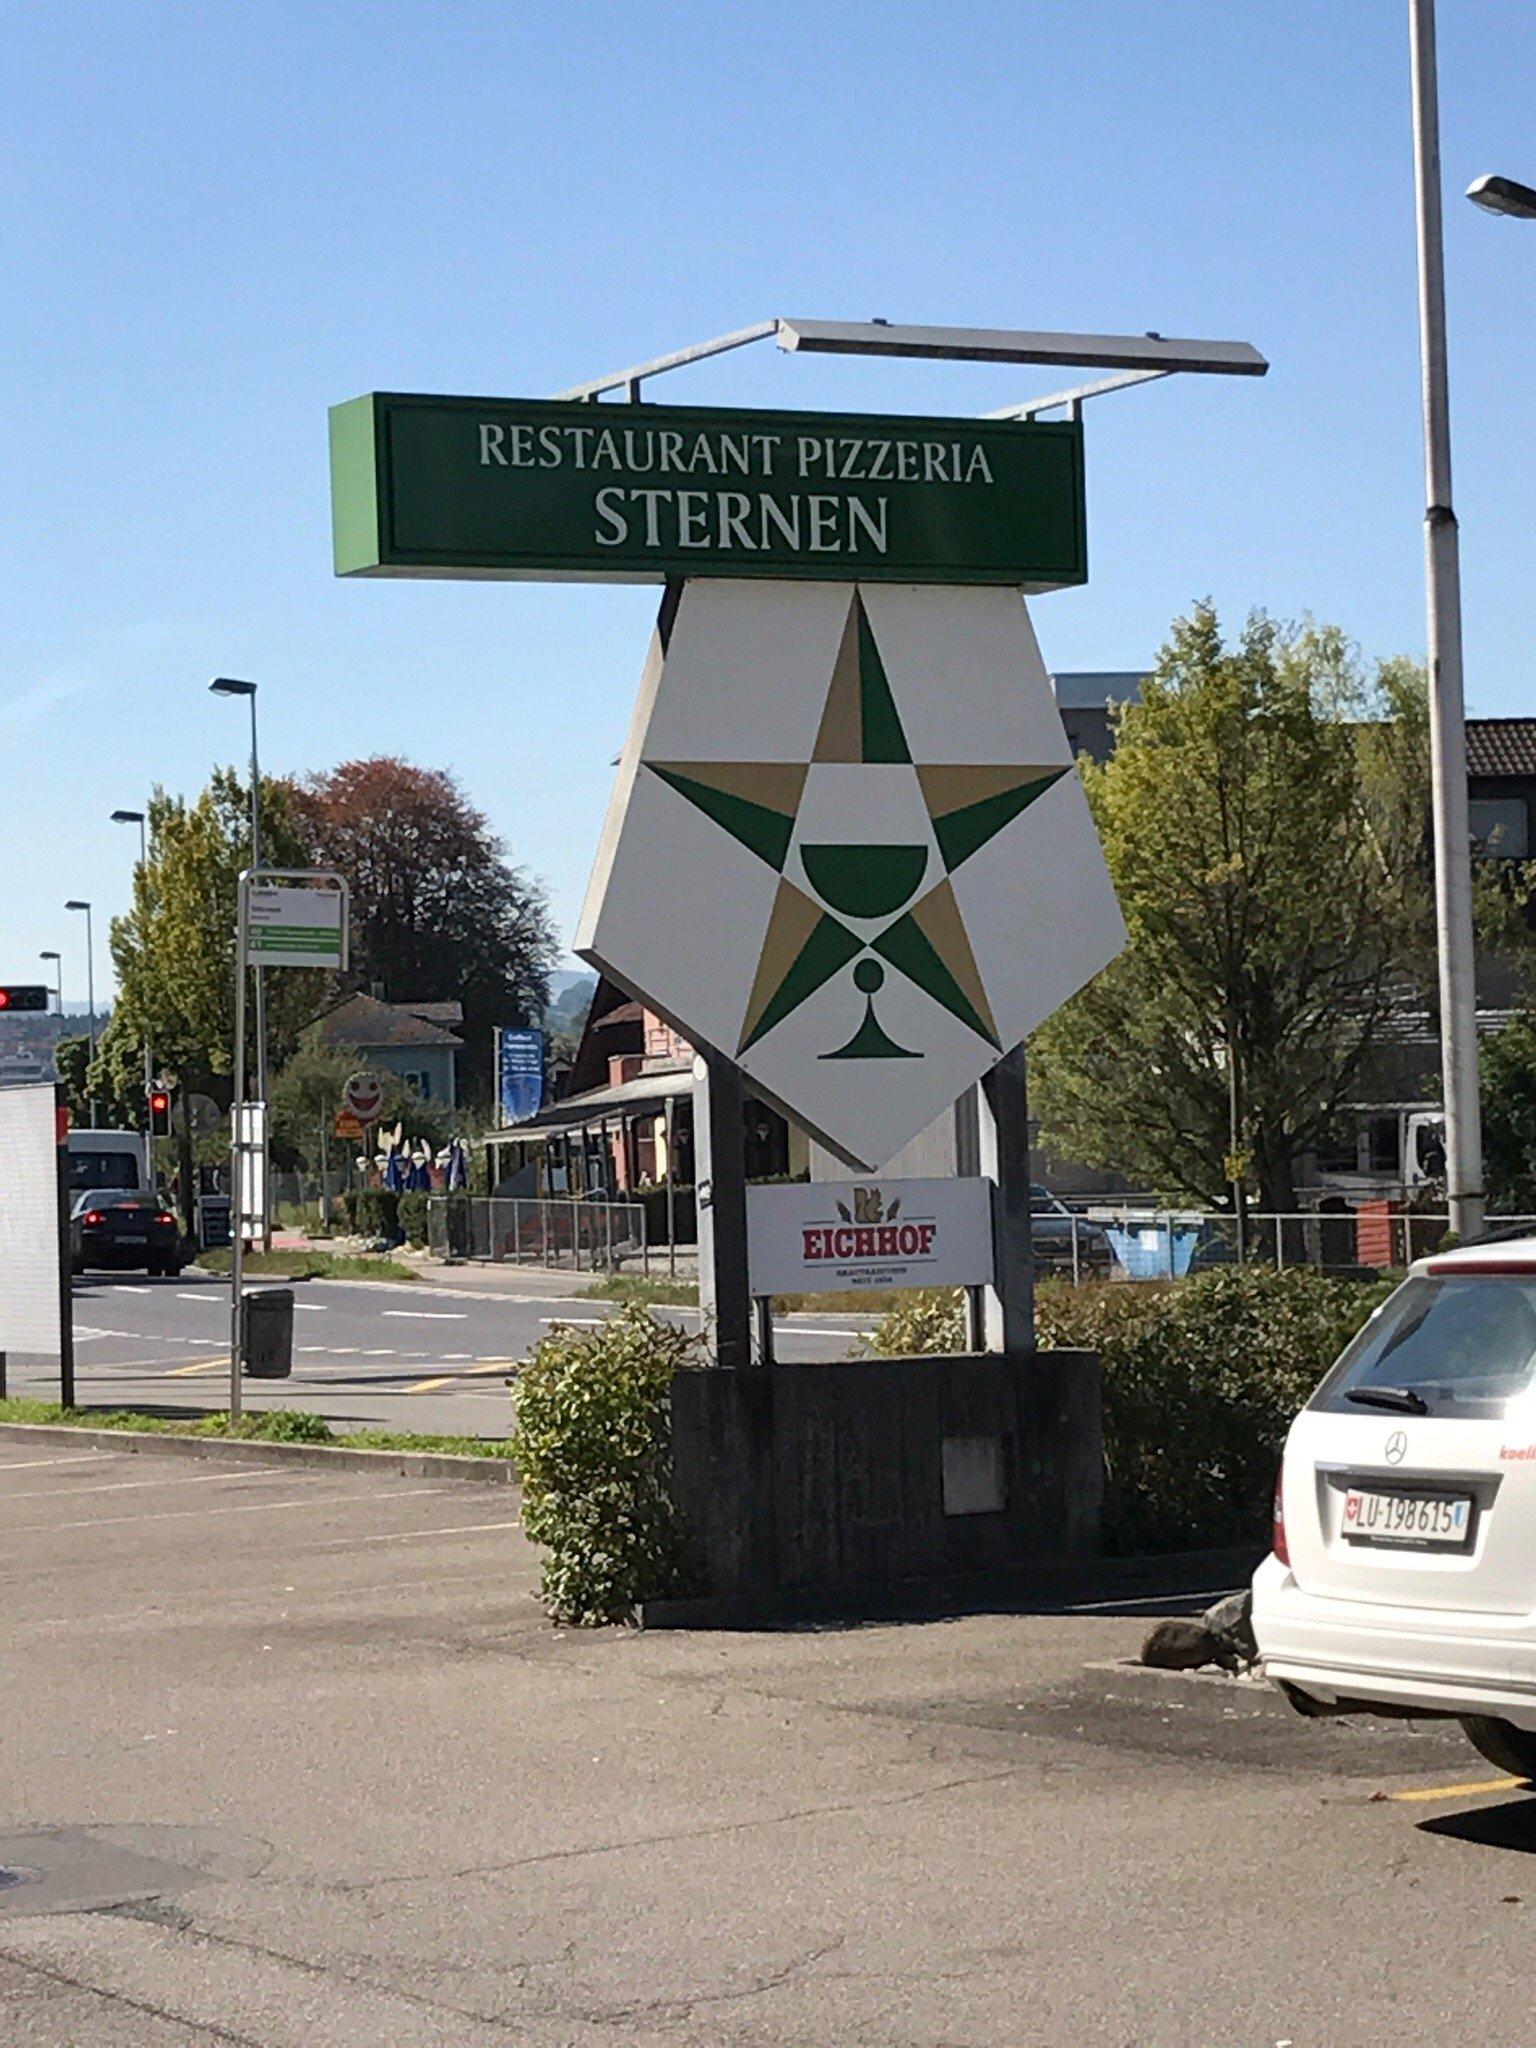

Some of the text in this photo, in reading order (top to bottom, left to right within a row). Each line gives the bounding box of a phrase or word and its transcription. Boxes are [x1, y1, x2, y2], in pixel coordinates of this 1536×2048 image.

[479, 423, 994, 484] RESTAURANT PIZZERIA
[595, 487, 888, 554] STERNEN
[802, 1224, 937, 1260] EICHHOF
